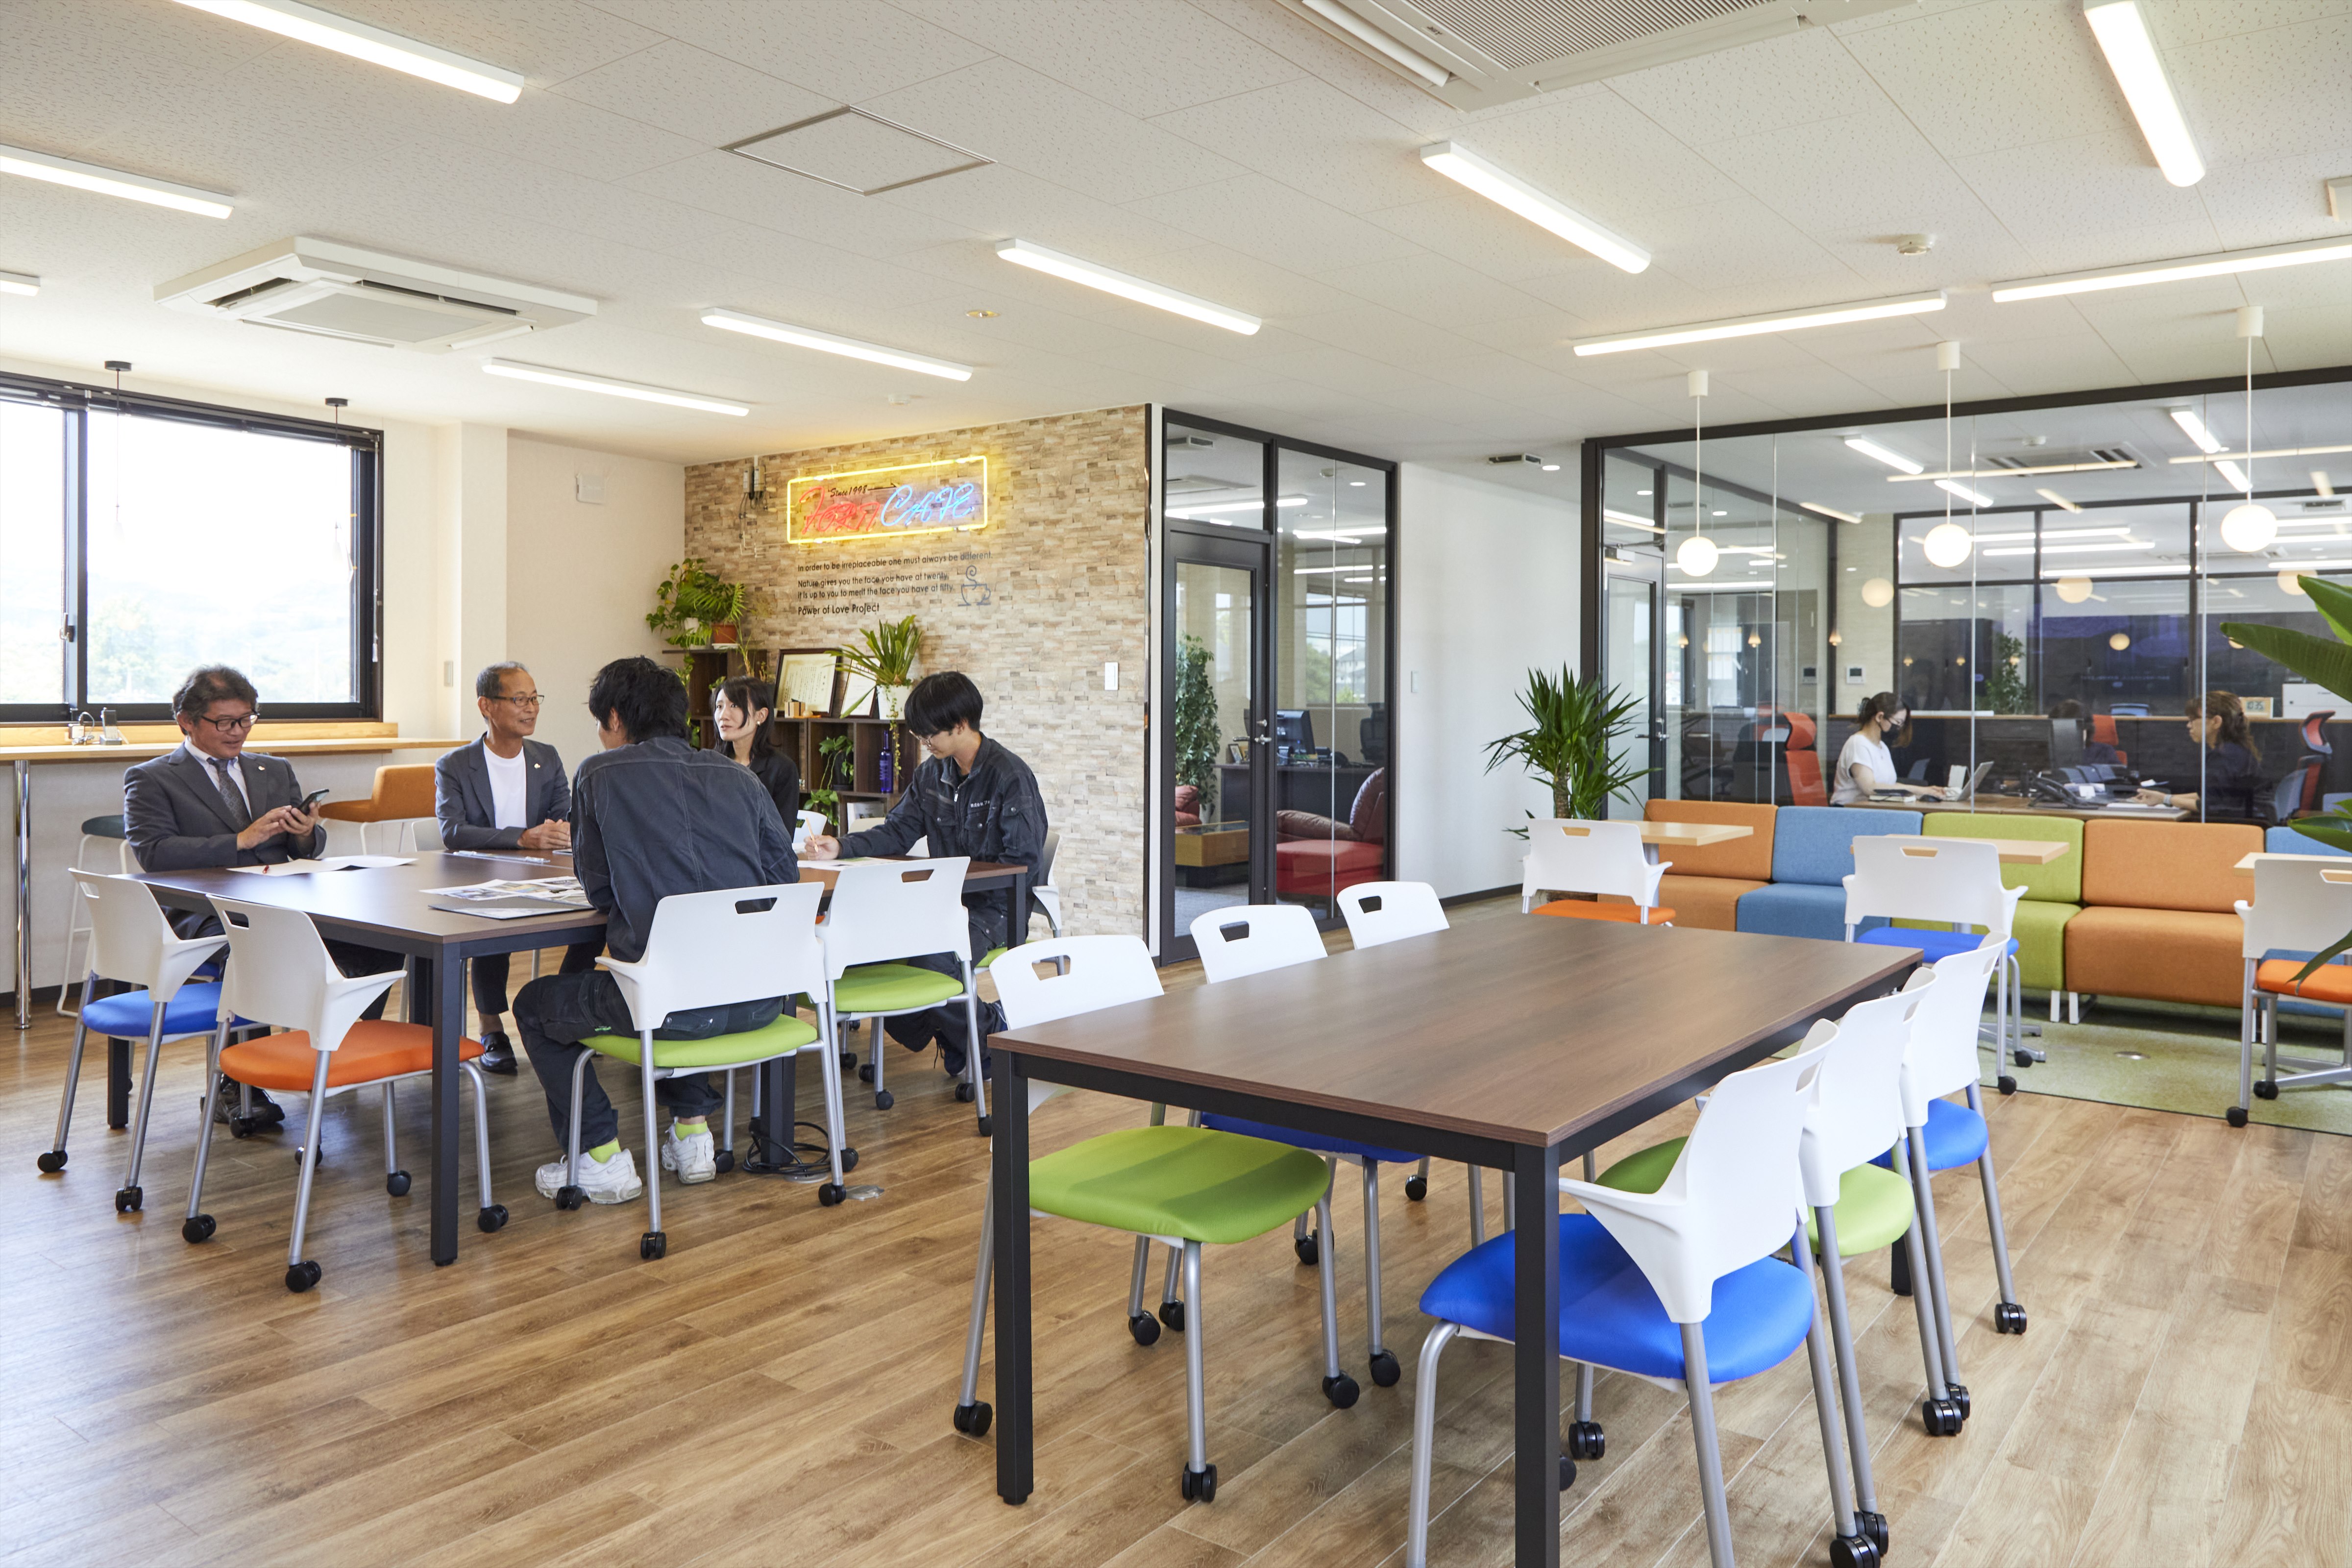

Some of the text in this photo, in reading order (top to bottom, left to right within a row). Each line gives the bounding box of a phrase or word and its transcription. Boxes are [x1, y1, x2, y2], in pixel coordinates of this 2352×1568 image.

[842, 559, 886, 569] irreplaceable
[904, 556, 920, 564] must
[922, 555, 946, 564] always
[960, 550, 993, 561] different.
[820, 579, 837, 588] gives
[838, 579, 850, 587] you
[882, 575, 894, 585] you
[915, 572, 922, 581] at
[827, 591, 838, 599] you
[880, 587, 895, 595] face
[897, 587, 909, 596] you
[931, 583, 938, 591] at
[798, 603, 880, 615] Power of Love Project
